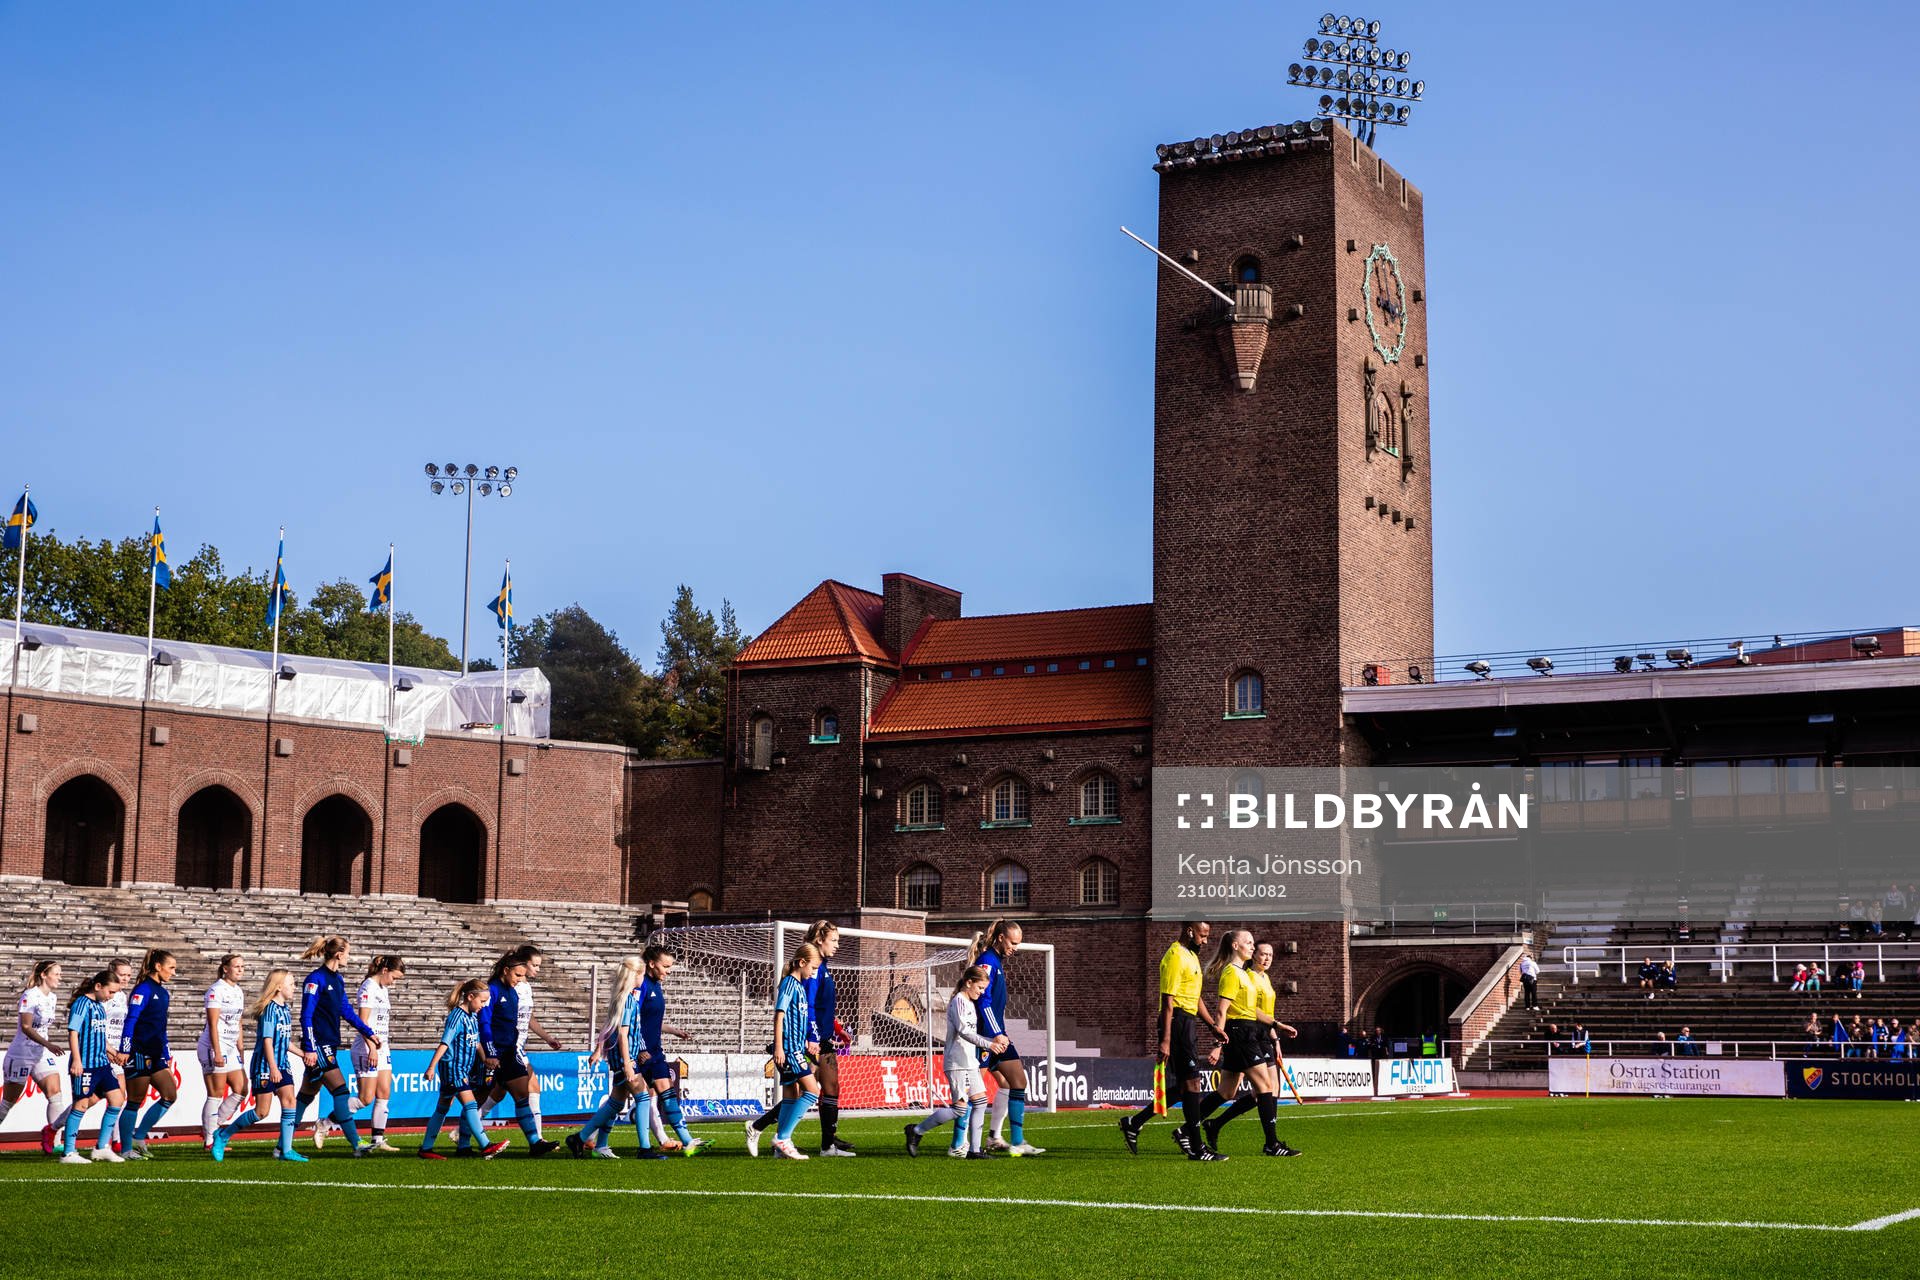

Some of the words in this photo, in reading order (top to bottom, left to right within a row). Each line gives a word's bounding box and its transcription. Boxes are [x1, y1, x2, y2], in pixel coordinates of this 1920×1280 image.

[1610, 1059, 1656, 1079] Östra
[1661, 1062, 1720, 1080] Station
[1024, 1065, 1088, 1102] Altrna
[1610, 1079, 1720, 1094] Järnvägsrestaurangen
[1831, 1072, 1920, 1087] STOCKHOL
